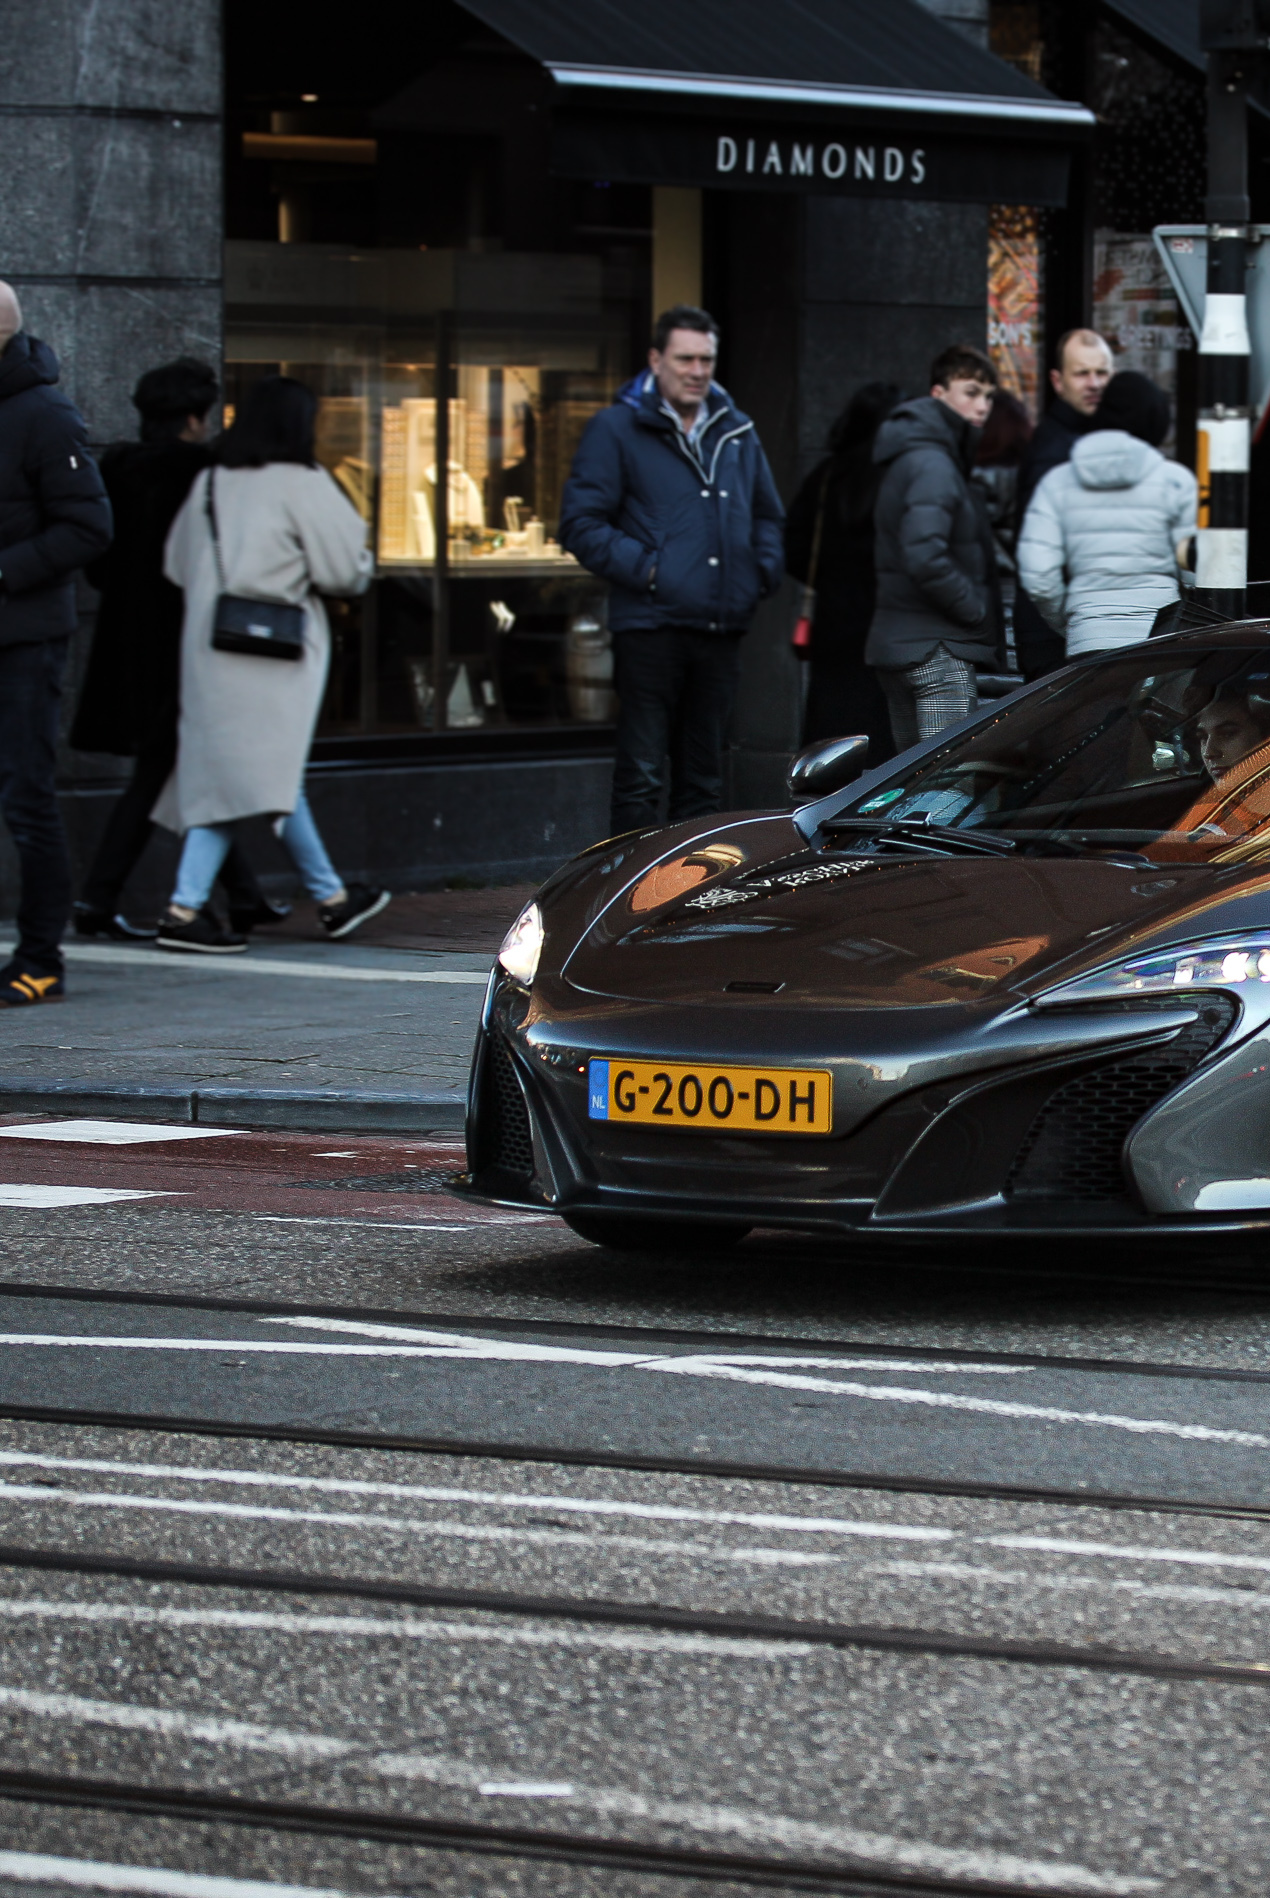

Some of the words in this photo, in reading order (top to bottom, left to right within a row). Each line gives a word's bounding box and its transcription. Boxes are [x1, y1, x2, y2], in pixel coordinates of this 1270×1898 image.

[717, 136, 926, 184] DIAMONDS
[592, 1094, 606, 1110] NL
[614, 1069, 816, 1123] G-200-DH
